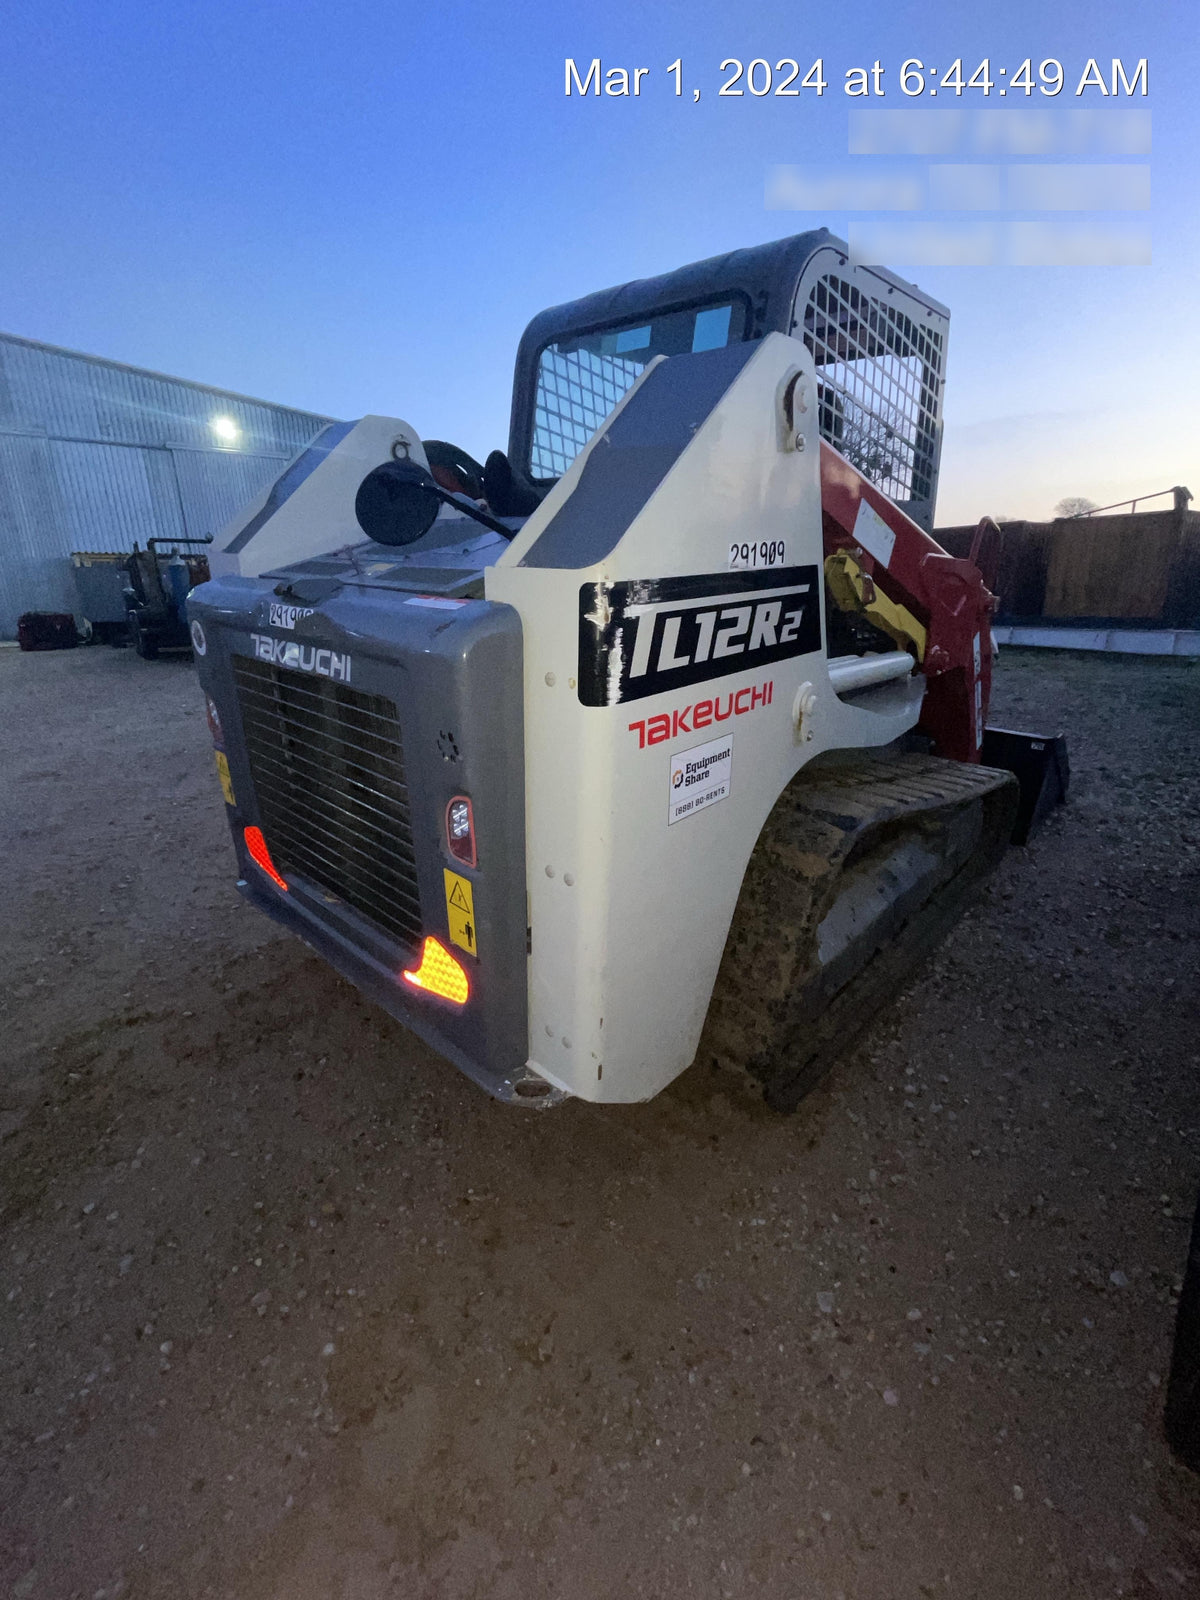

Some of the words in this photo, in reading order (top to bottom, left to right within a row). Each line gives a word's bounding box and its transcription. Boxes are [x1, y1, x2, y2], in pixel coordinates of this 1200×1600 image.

[730, 540, 785, 567] 291909
[251, 633, 351, 682] TAKEUCHI
[628, 680, 774, 749] TAKEUCHI
[685, 748, 731, 774] Equipment
[684, 769, 711, 787] Share
